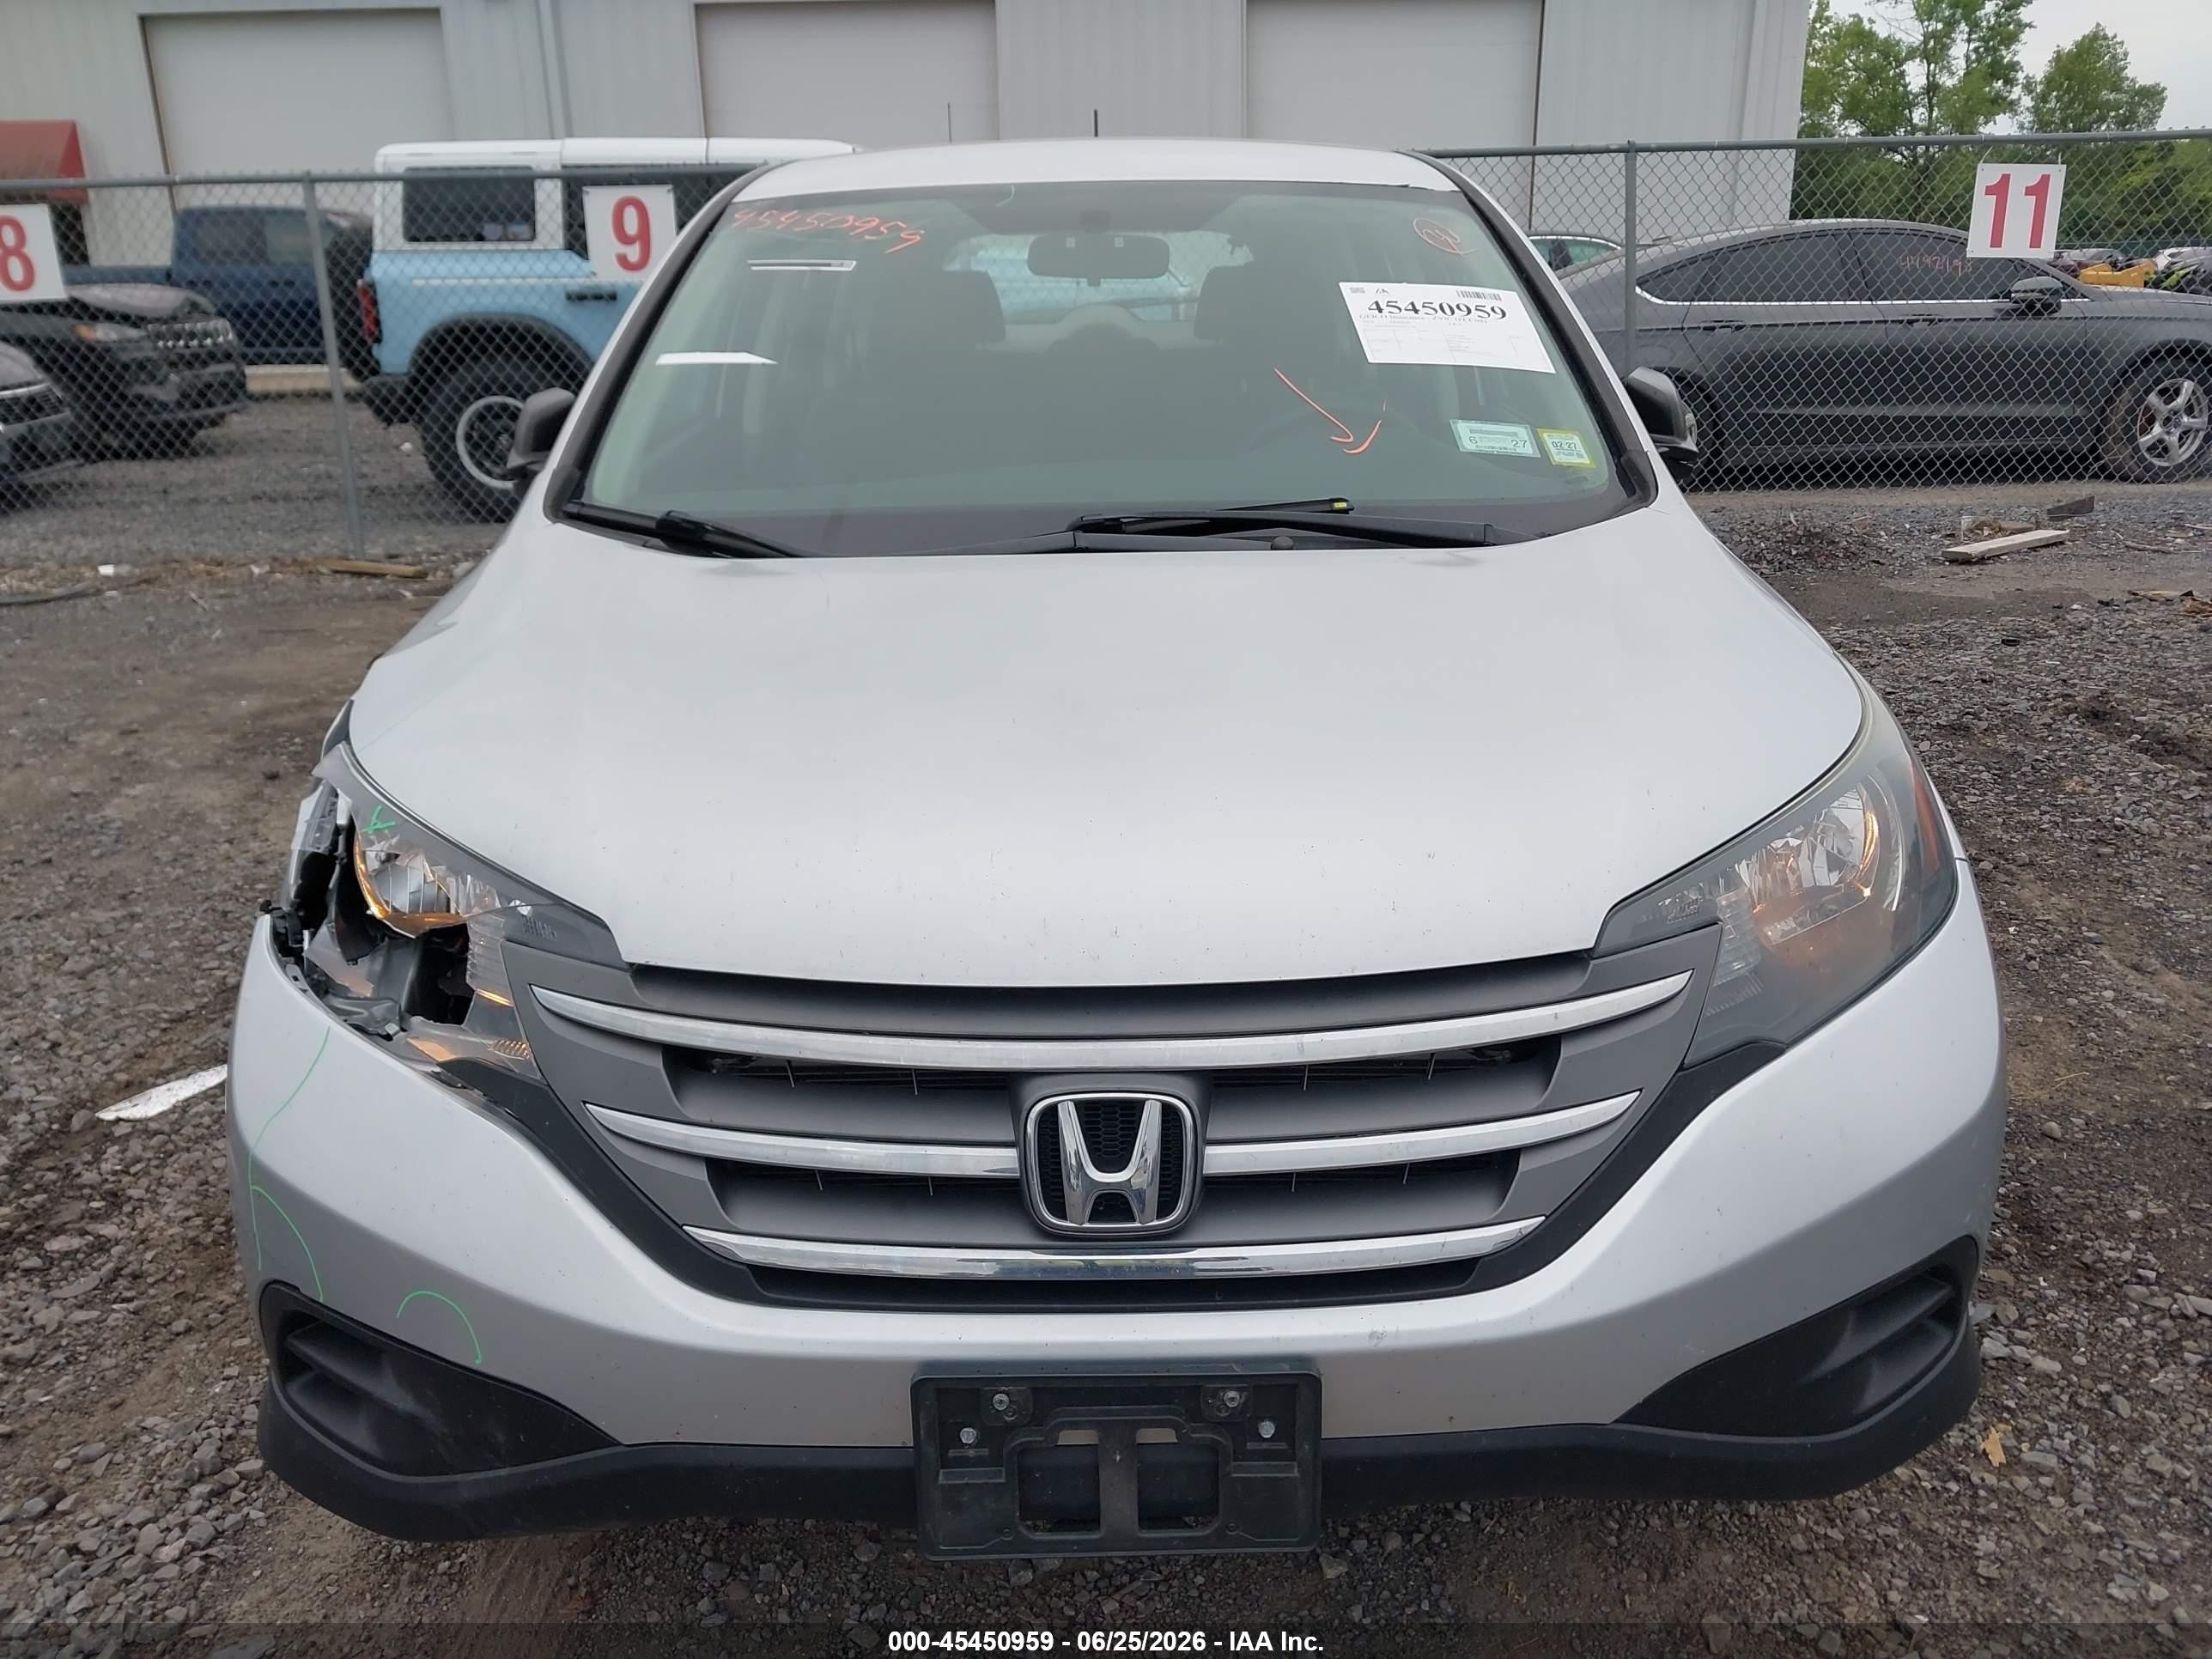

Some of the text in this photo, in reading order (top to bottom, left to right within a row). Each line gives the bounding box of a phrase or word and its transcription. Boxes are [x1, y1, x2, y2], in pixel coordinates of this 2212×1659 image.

[611, 195, 652, 272] 9
[1984, 173, 2051, 248] 11
[0, 215, 35, 292] 8
[1368, 300, 1507, 320] 45450959
[1511, 439, 1528, 448] 27
